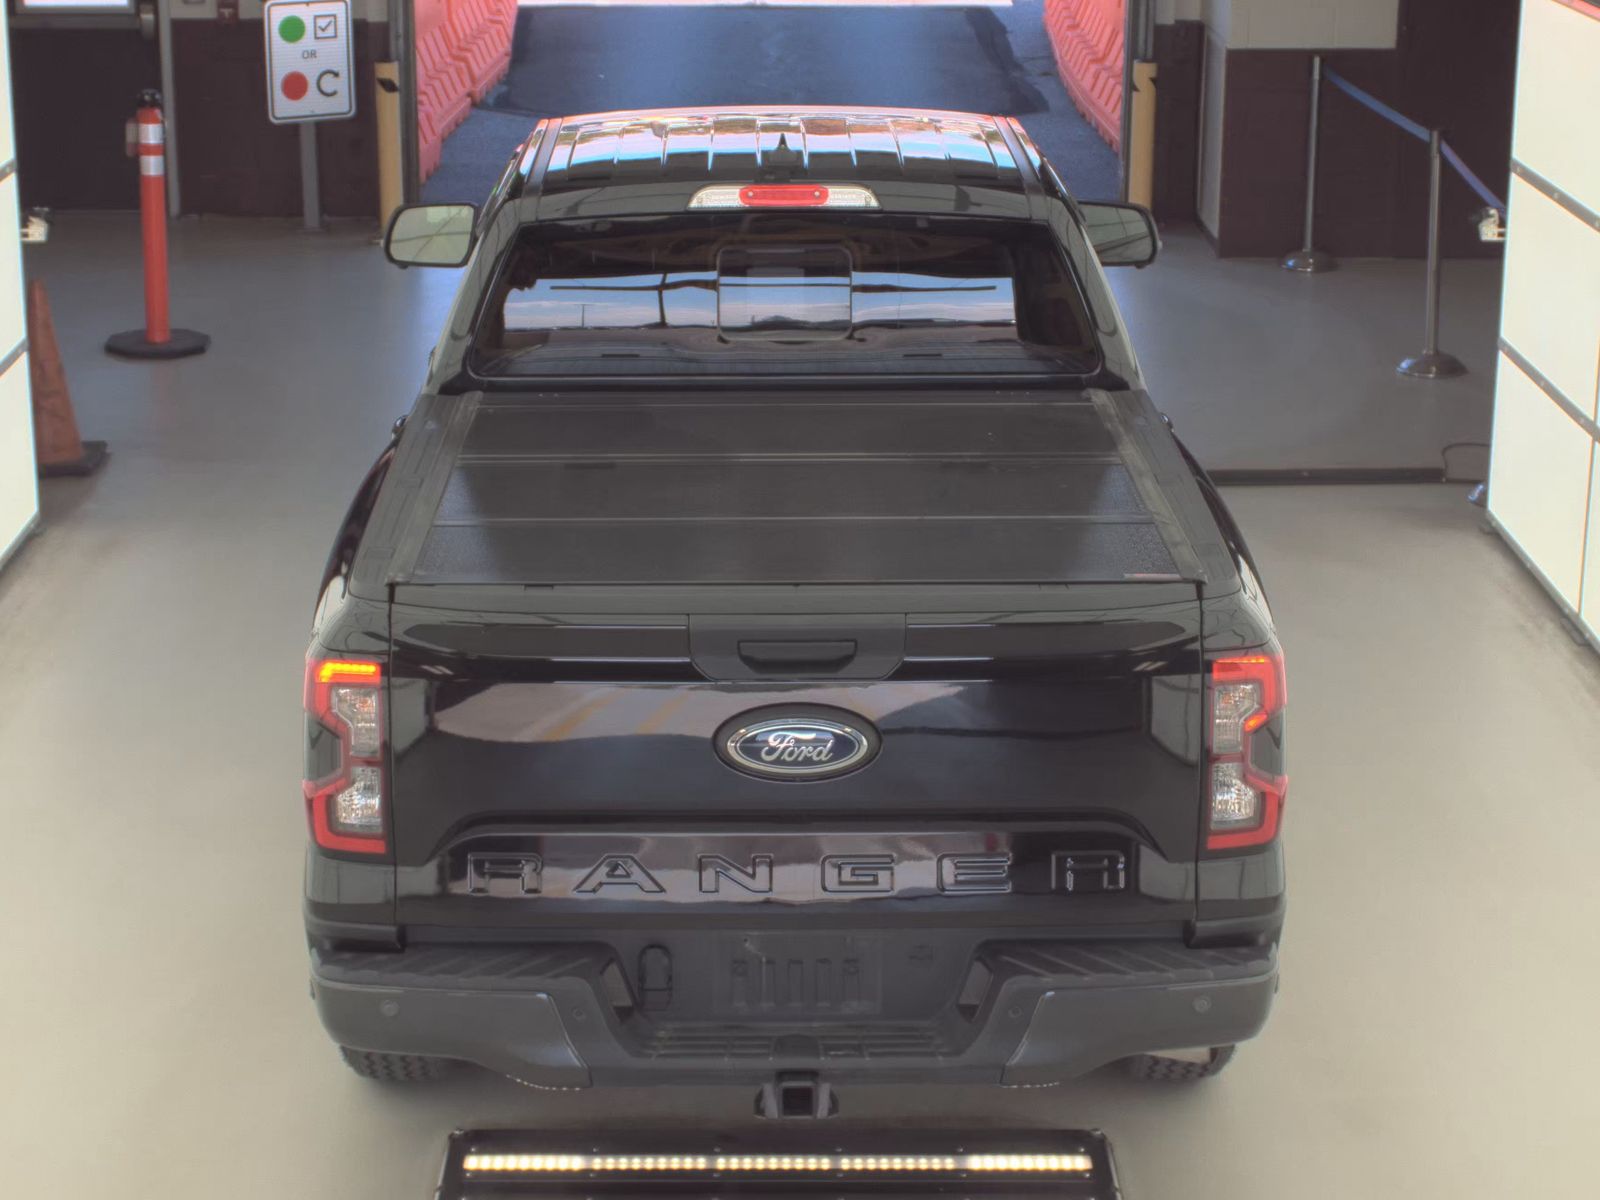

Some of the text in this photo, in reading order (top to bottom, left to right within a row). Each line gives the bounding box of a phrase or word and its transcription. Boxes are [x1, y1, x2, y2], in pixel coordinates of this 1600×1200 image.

[302, 50, 318, 60] OR
[761, 731, 834, 762] Ford
[468, 852, 1127, 894] RANGER
